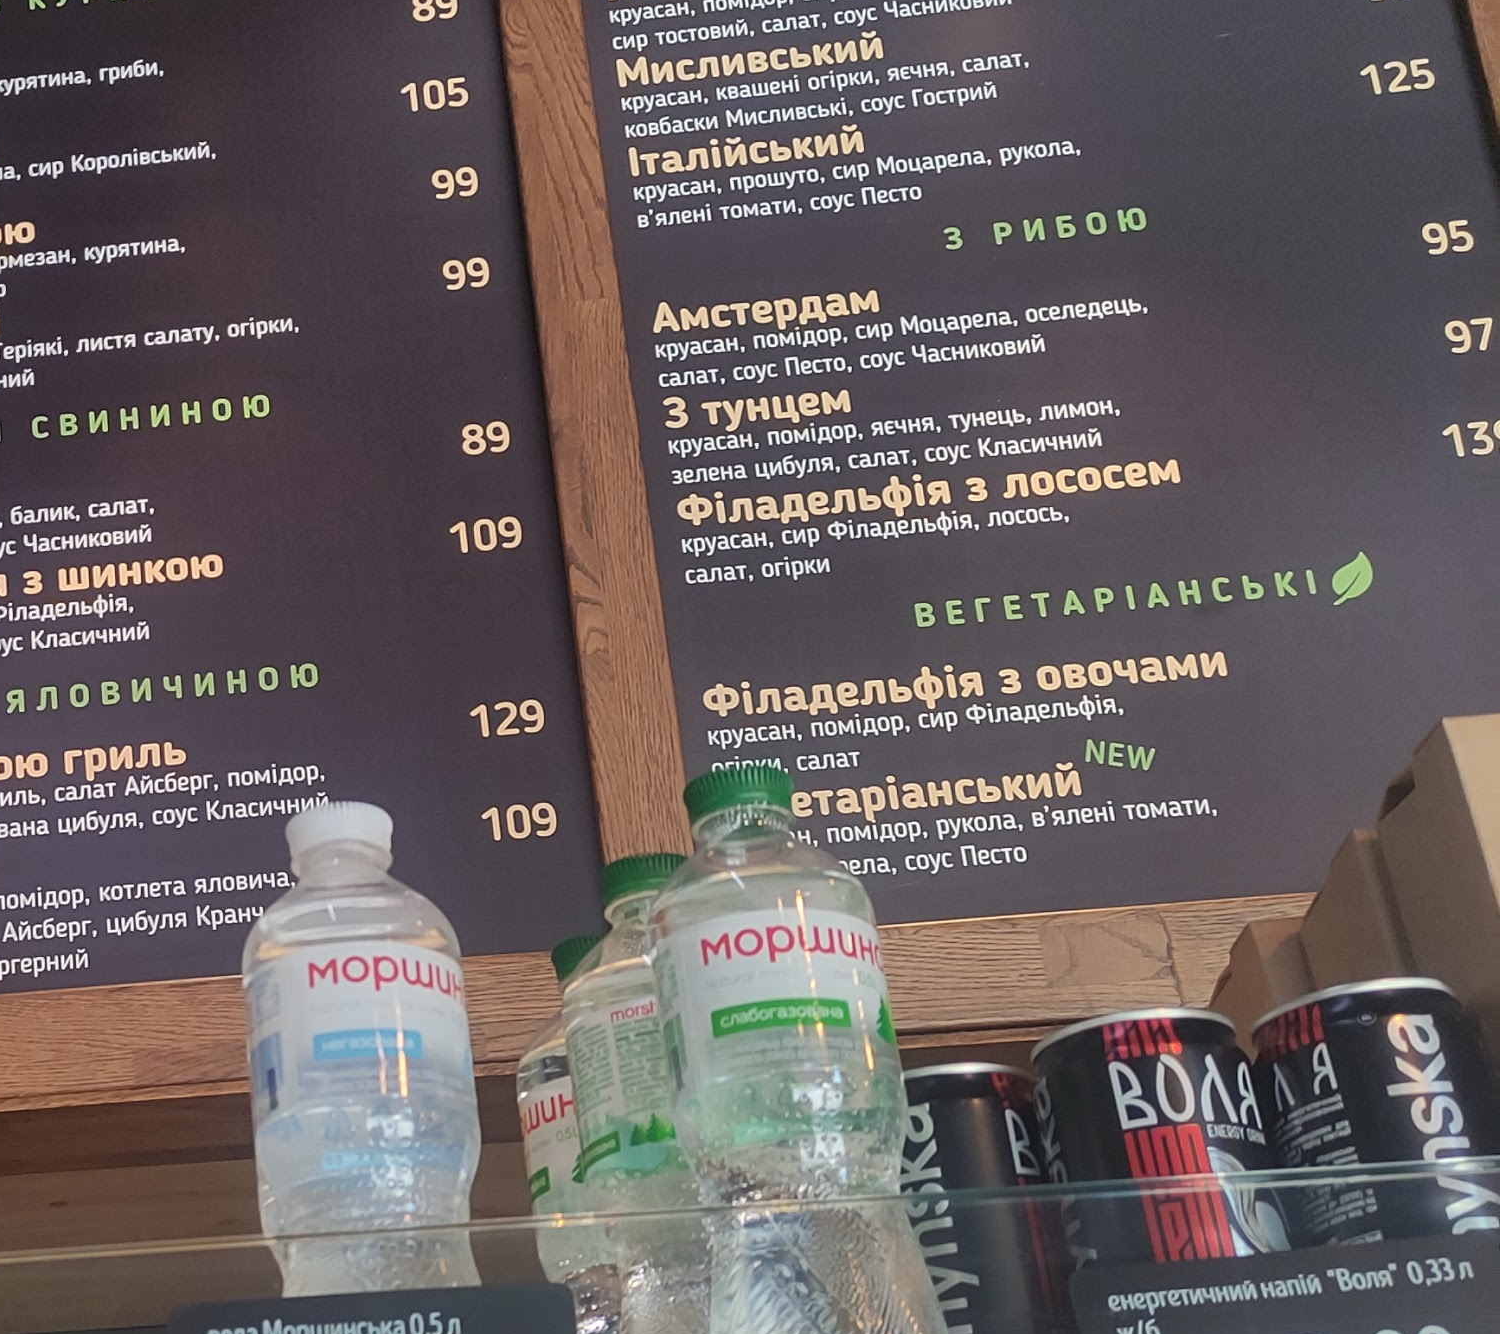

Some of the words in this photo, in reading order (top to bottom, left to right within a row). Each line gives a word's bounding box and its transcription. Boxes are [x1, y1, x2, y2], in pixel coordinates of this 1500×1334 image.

[611, 32, 650, 53] сир
[653, 17, 756, 47] тостовий,
[760, 12, 828, 35] салат,
[832, 6, 879, 28] соус
[98, 58, 165, 86] гриби,
[614, 30, 885, 89] Мисливський
[1359, 57, 1436, 96] 125
[399, 76, 470, 113] 105
[619, 88, 710, 116] круасан,
[714, 73, 802, 102] квашені
[806, 68, 881, 93] огірки,
[885, 60, 957, 83] яєчня,
[960, 52, 1031, 74] салат,
[627, 123, 866, 178] Італійський
[430, 165, 480, 201] 99
[632, 178, 723, 205] круасан,
[728, 167, 827, 195] прошуто,
[831, 161, 871, 183] сир
[874, 149, 993, 177] Моцарела,
[997, 139, 1082, 168] рукола,
[992, 206, 1148, 246] РИБОЮ
[1420, 218, 1475, 256] 95
[83, 237, 187, 266] курятина,
[441, 256, 491, 292] 99
[651, 288, 881, 335] Амстердам
[653, 336, 747, 364] круасан,
[751, 325, 849, 351] помідор,
[854, 321, 895, 343] сир
[898, 309, 1020, 337] Моцарела,
[1023, 297, 1149, 324] оселедець,
[74, 332, 138, 354] листя
[142, 324, 221, 347] салату,
[226, 315, 301, 341] огірки,
[1443, 316, 1494, 355] 97
[30, 393, 271, 440] СВИНИНОЮ
[699, 388, 853, 433] тунцем
[460, 420, 511, 457] 89
[1441, 418, 1500, 459] 13
[676, 472, 953, 527] Філадельфія
[1002, 458, 1182, 500] лососем
[448, 515, 523, 555] 109
[56, 553, 225, 593] шинкою
[913, 568, 1318, 629] ВЕГЕТАРІАНСЬКІ
[5, 662, 319, 715] ЯЛОВИЧИНОЮ
[701, 663, 985, 718] Філадельфія
[1035, 650, 1229, 692] овочами
[468, 698, 546, 739] 129
[706, 722, 804, 751] круасан,
[809, 712, 912, 739] помідор,
[916, 709, 959, 734] сир
[964, 692, 1125, 726] Філадельфія,
[62, 740, 188, 783] гриль
[1084, 739, 1156, 770] NEW
[53, 781, 118, 803] салат
[123, 770, 220, 798] Айсберг,
[226, 762, 326, 789] помідор,
[790, 761, 1083, 823] етаріанський
[480, 801, 558, 842] 109
[97, 878, 188, 903] котлета
[193, 870, 297, 895] яловича,
[1107, 1053, 1264, 1132] ВОЛЯ
[1107, 1280, 1259, 1316] енергетичний
[1261, 1273, 1323, 1301] напій
[1325, 1262, 1399, 1293] "Воля"
[1405, 1256, 1457, 1287] 0,33
[1459, 1259, 1475, 1282] л
